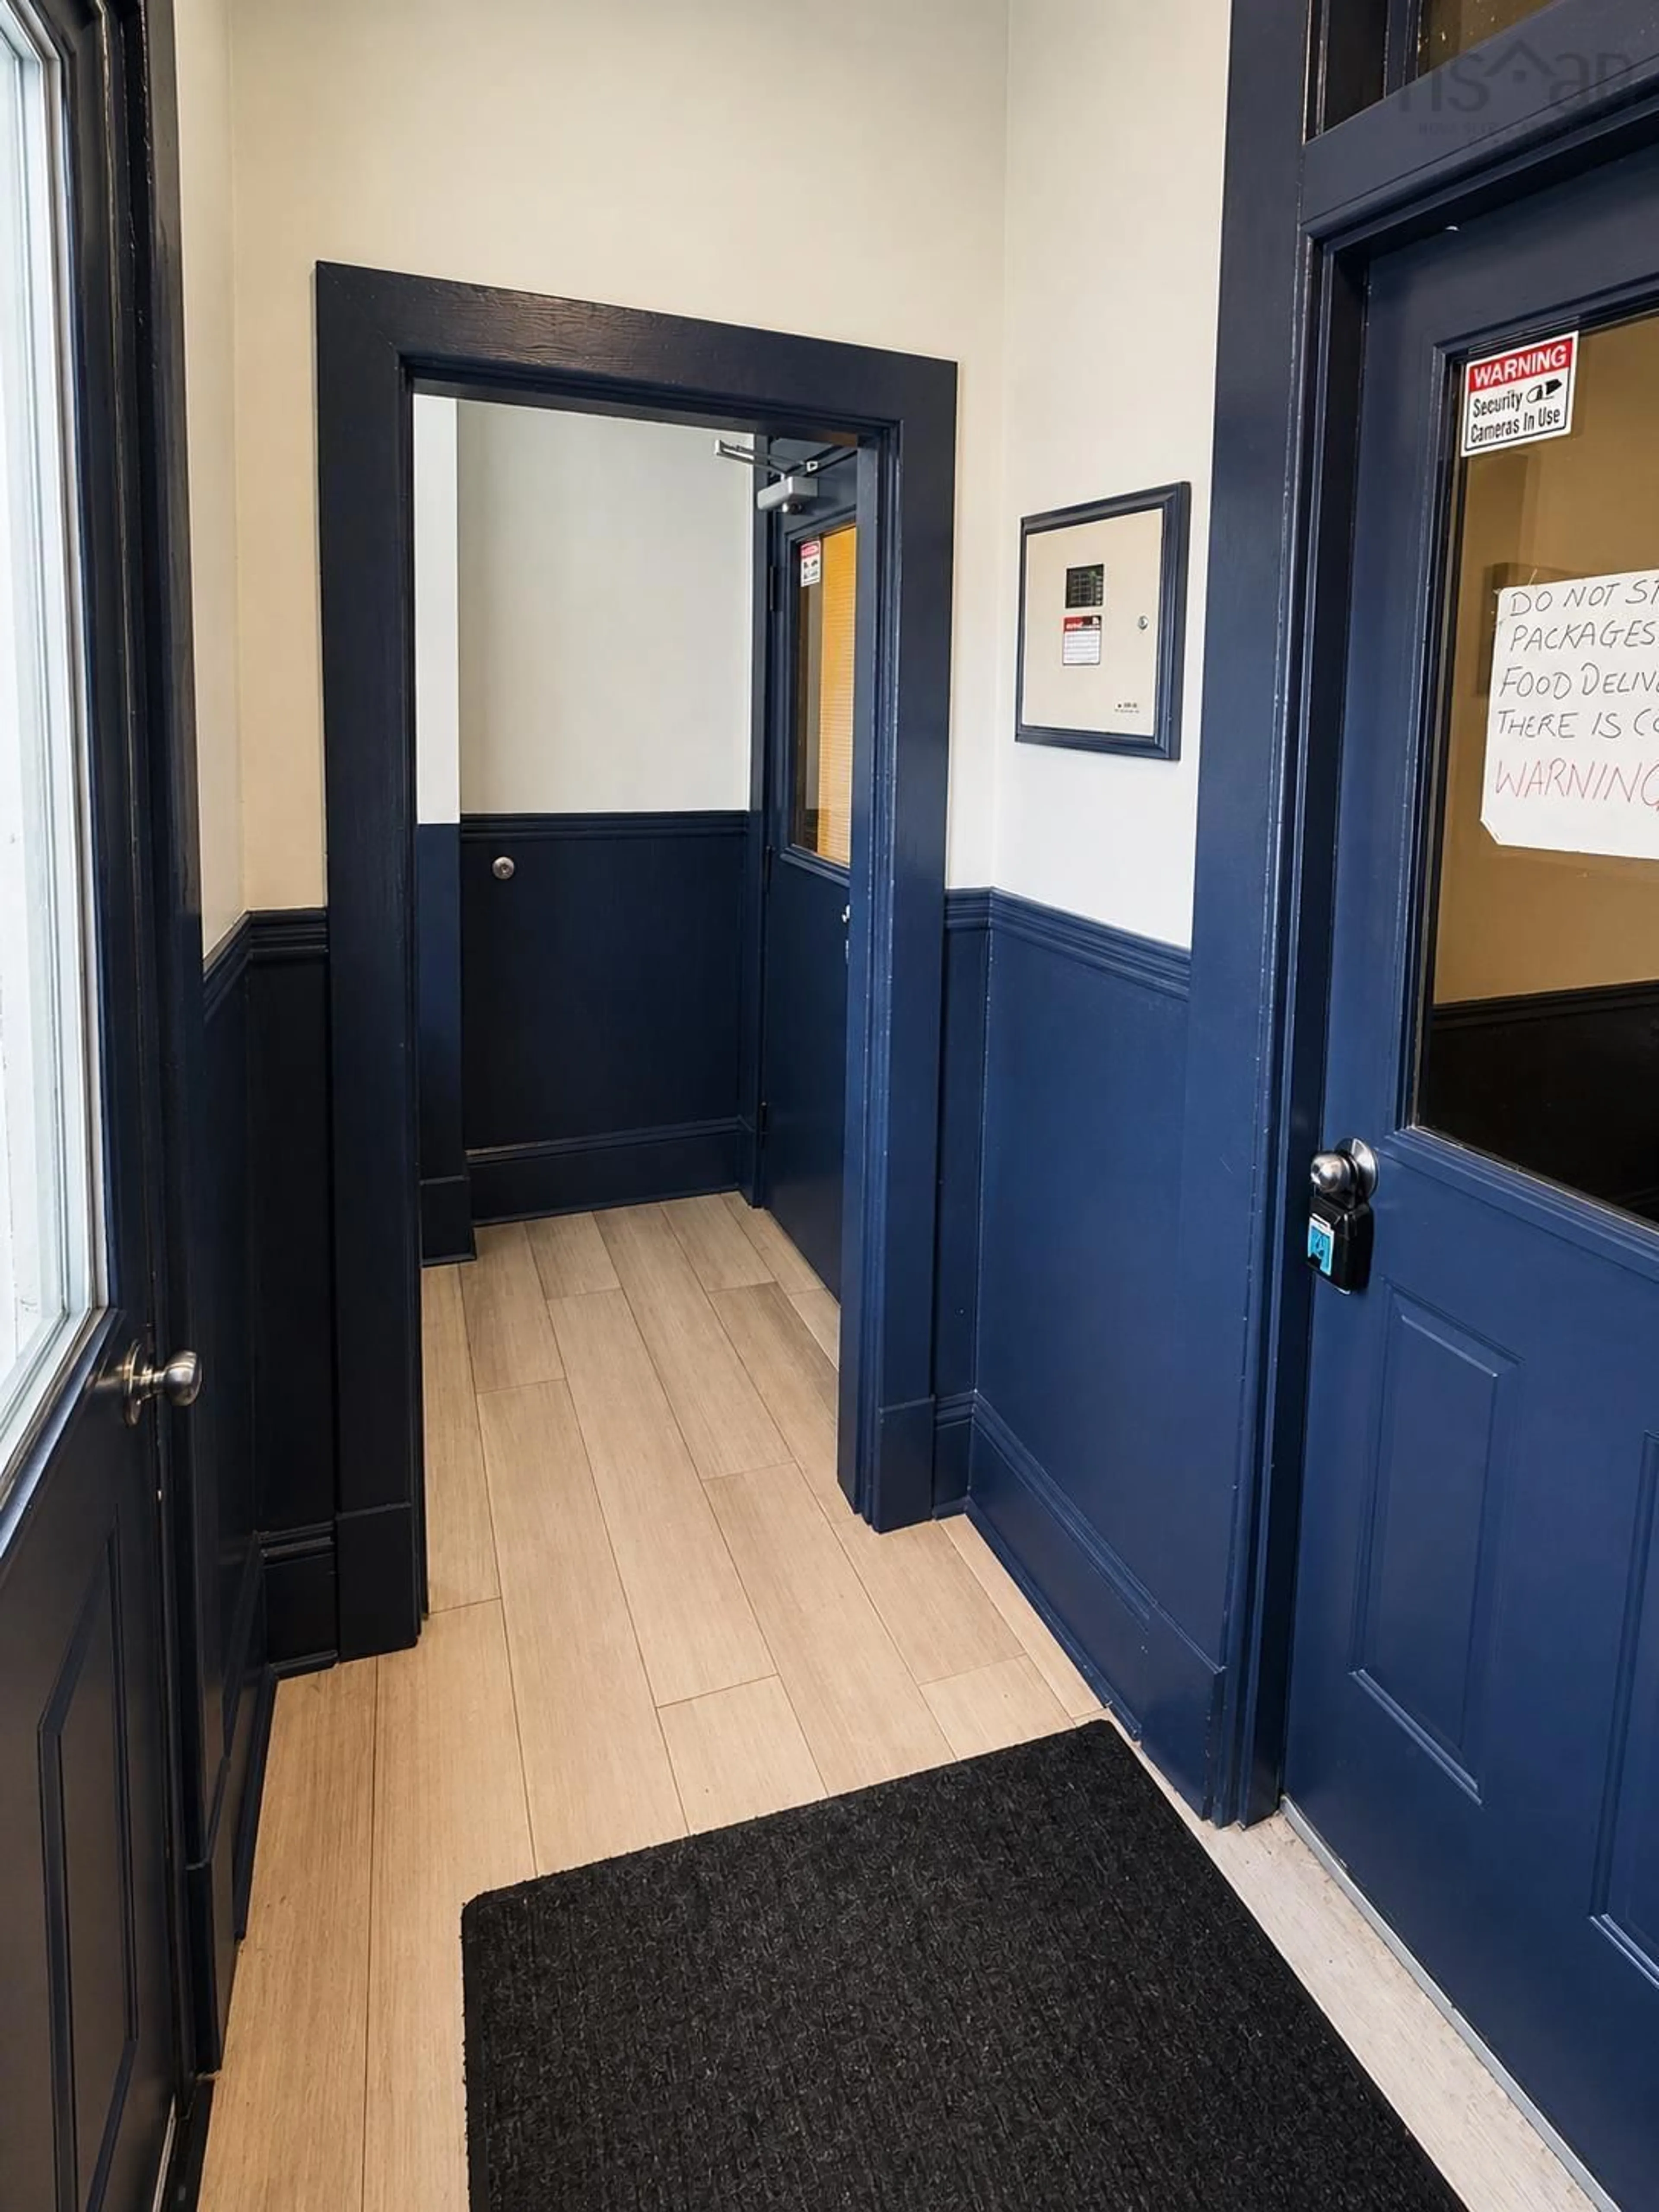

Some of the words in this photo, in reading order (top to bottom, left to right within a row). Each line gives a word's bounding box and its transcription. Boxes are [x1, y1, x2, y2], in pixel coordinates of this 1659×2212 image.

[1474, 345, 1567, 388] WARNING
[1473, 390, 1523, 417] Security
[1471, 418, 1519, 443] Cameras
[1523, 412, 1535, 431] In
[1538, 407, 1560, 427] Use
[1510, 591, 1553, 617] DO
[1563, 582, 1621, 607] NOT
[1498, 666, 1572, 700] FOOD
[1498, 709, 1580, 738] THERE
[1591, 712, 1622, 739] IS
